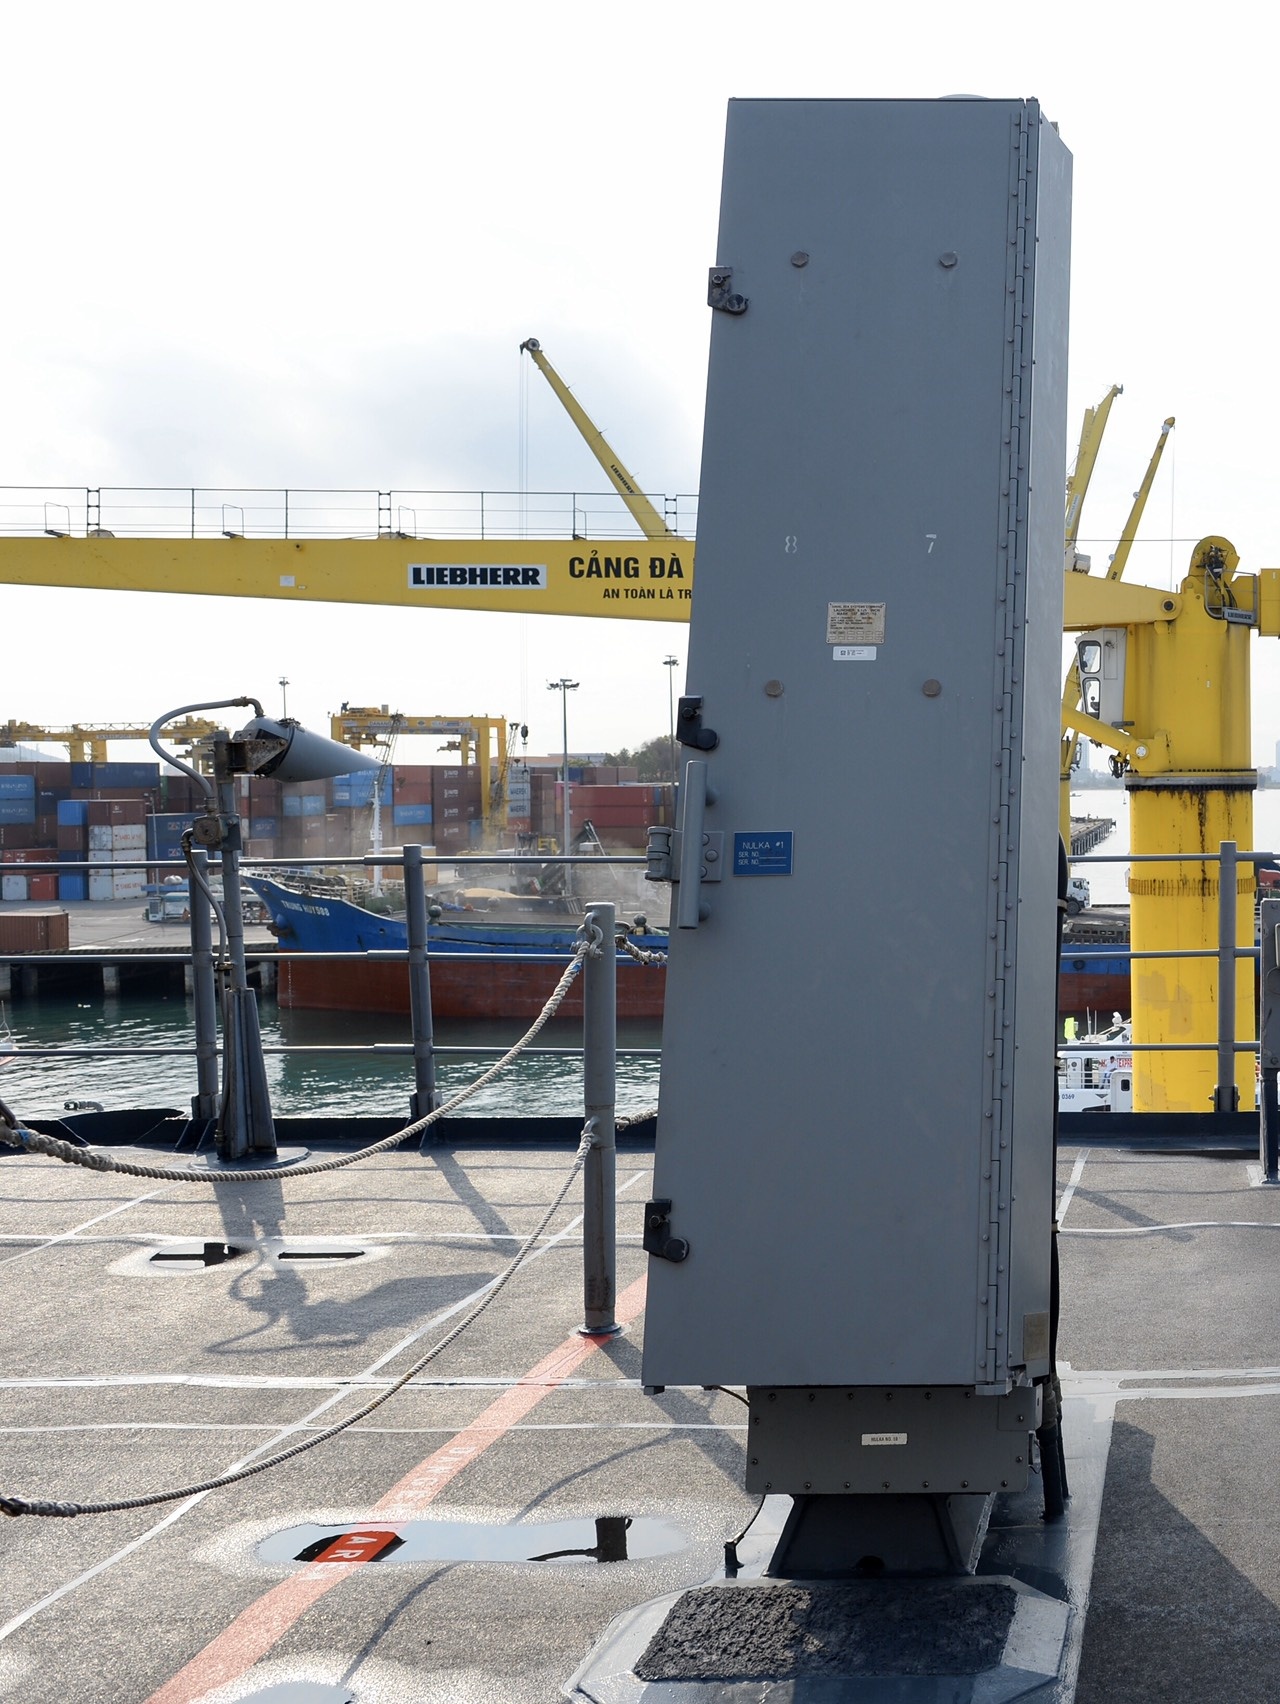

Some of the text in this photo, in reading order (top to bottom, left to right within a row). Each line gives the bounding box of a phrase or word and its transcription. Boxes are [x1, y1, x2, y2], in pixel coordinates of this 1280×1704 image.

[784, 535, 797, 554] 8
[925, 533, 937, 553] 7
[569, 550, 684, 579] CẢNG ĐÀ
[412, 567, 540, 586] LIEBHERR
[603, 587, 692, 599] AN TOÀN LÀ TR
[742, 841, 784, 850] NULKA #1
